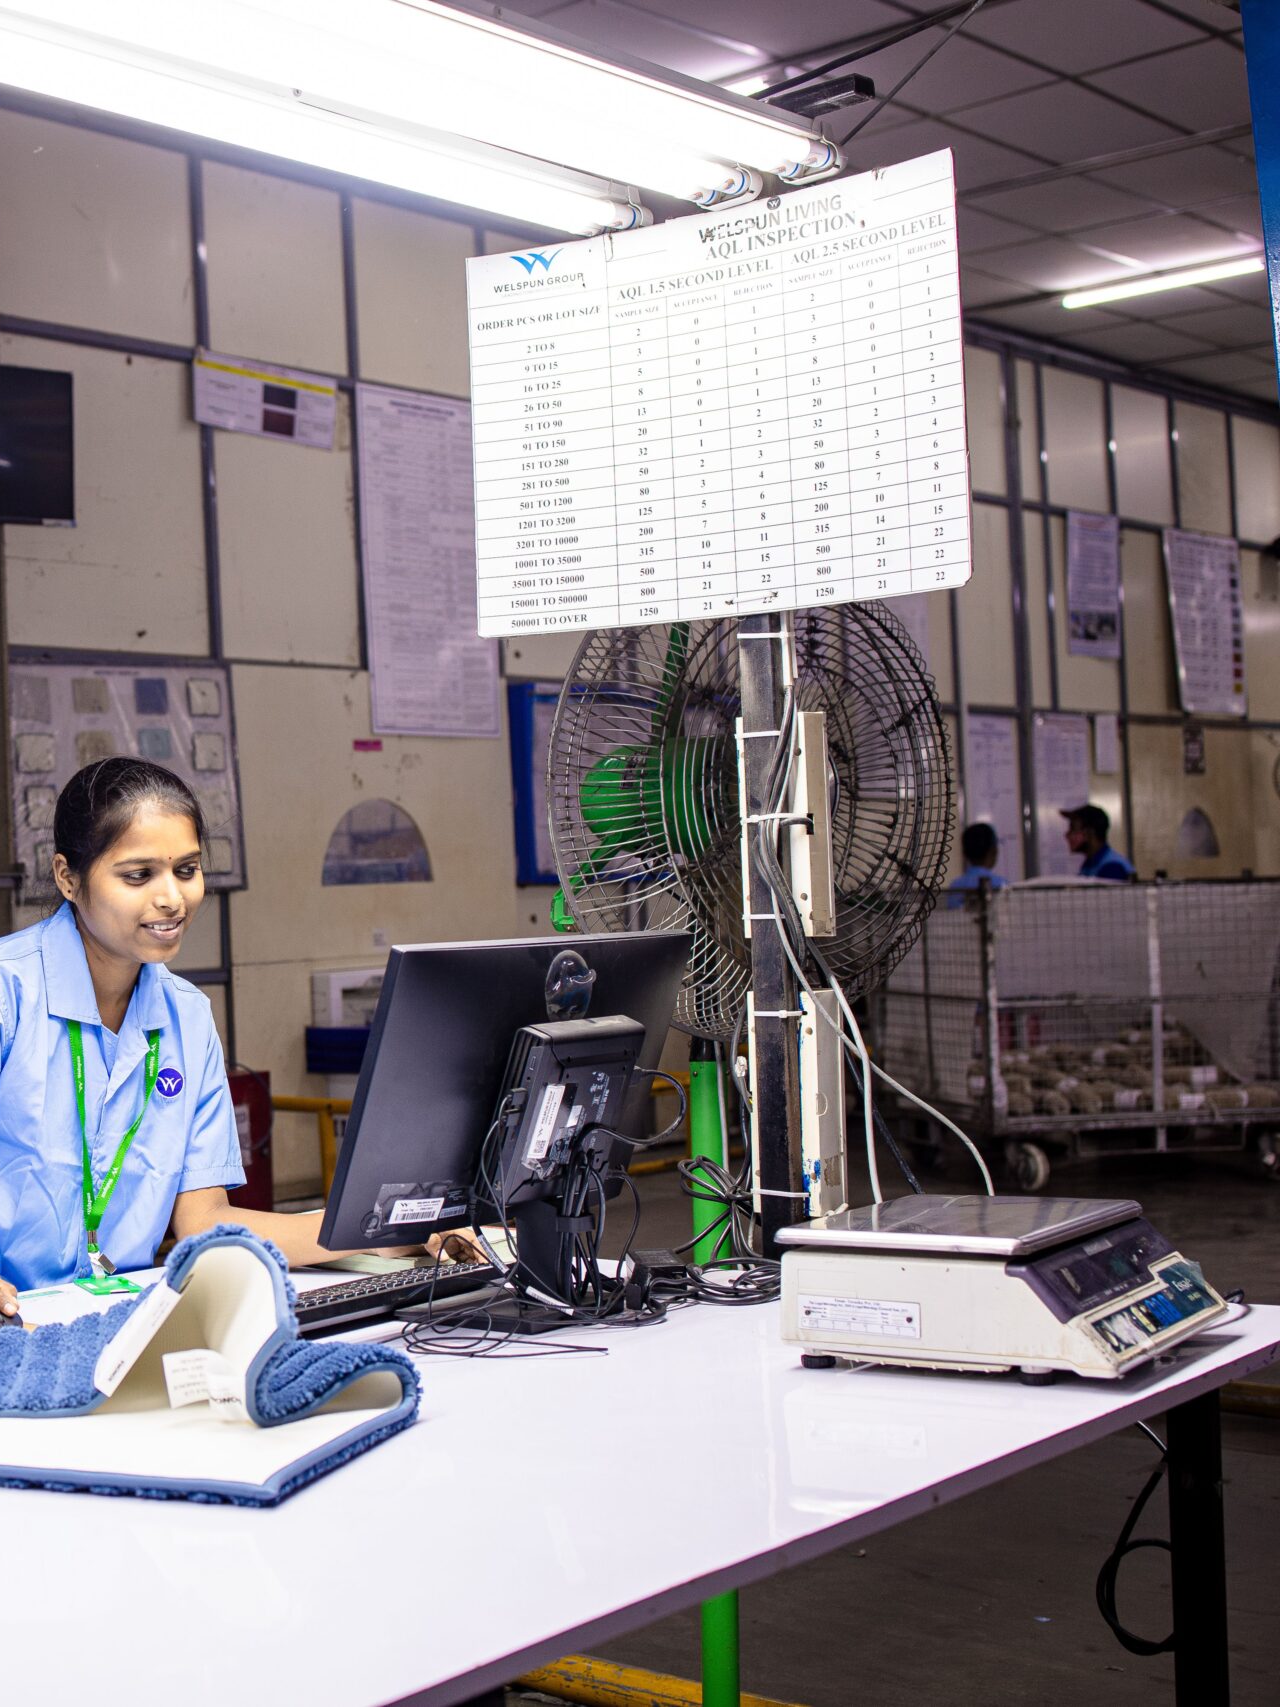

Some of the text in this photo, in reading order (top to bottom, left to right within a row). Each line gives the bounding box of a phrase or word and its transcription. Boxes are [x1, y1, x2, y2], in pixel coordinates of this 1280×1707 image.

[705, 210, 856, 261] AQL INSPECTION
[786, 194, 842, 224] LIVING
[790, 213, 946, 265] AQL 2.5 SECOND LEVEL
[493, 279, 545, 293] WELSPUN
[546, 272, 584, 285] GROUP
[616, 258, 774, 301] AQL 1.5 SECOND LEVEL
[477, 306, 600, 331] ORDER PCS OR LOT SIZE
[533, 363, 546, 372] TO
[549, 361, 558, 370] 15
[637, 348, 641, 356] 3
[811, 314, 815, 323] 3
[536, 344, 547, 352] TO
[550, 342, 555, 350] 8
[637, 328, 640, 336] 2
[810, 293, 814, 301] 2
[524, 356, 818, 412] 26 TO 50 8 8
[525, 352, 934, 432] 51 TO 90 13 13 2
[536, 382, 549, 391] TO
[552, 380, 561, 389] 25
[638, 368, 642, 376] 5
[812, 335, 816, 344] 5
[522, 396, 936, 471] 151 TO 280 32 2 32 2 3
[523, 374, 935, 451] 91 TO 150 20 2 20 2
[520, 439, 939, 510] 501 TO 1200 80 3 4 80 5 6
[522, 418, 937, 490] 281 TO 500 50 2 3 50 3 4
[516, 483, 941, 549] 3201 TO 10000 200 7 8 200 10 11
[519, 461, 939, 530] 1201 TO 3200 125 5 6 125 7 8
[512, 527, 944, 589] 35001 TO 150000 500 14 15 500 21 22
[515, 505, 943, 569] 10001 TO 35000 315 10 11 315 14 15
[511, 549, 944, 608] 150001 TO 500000 800 21 22 800 21 22
[511, 571, 945, 628] 500001 TO OVER 1250 21 1250 21 22
